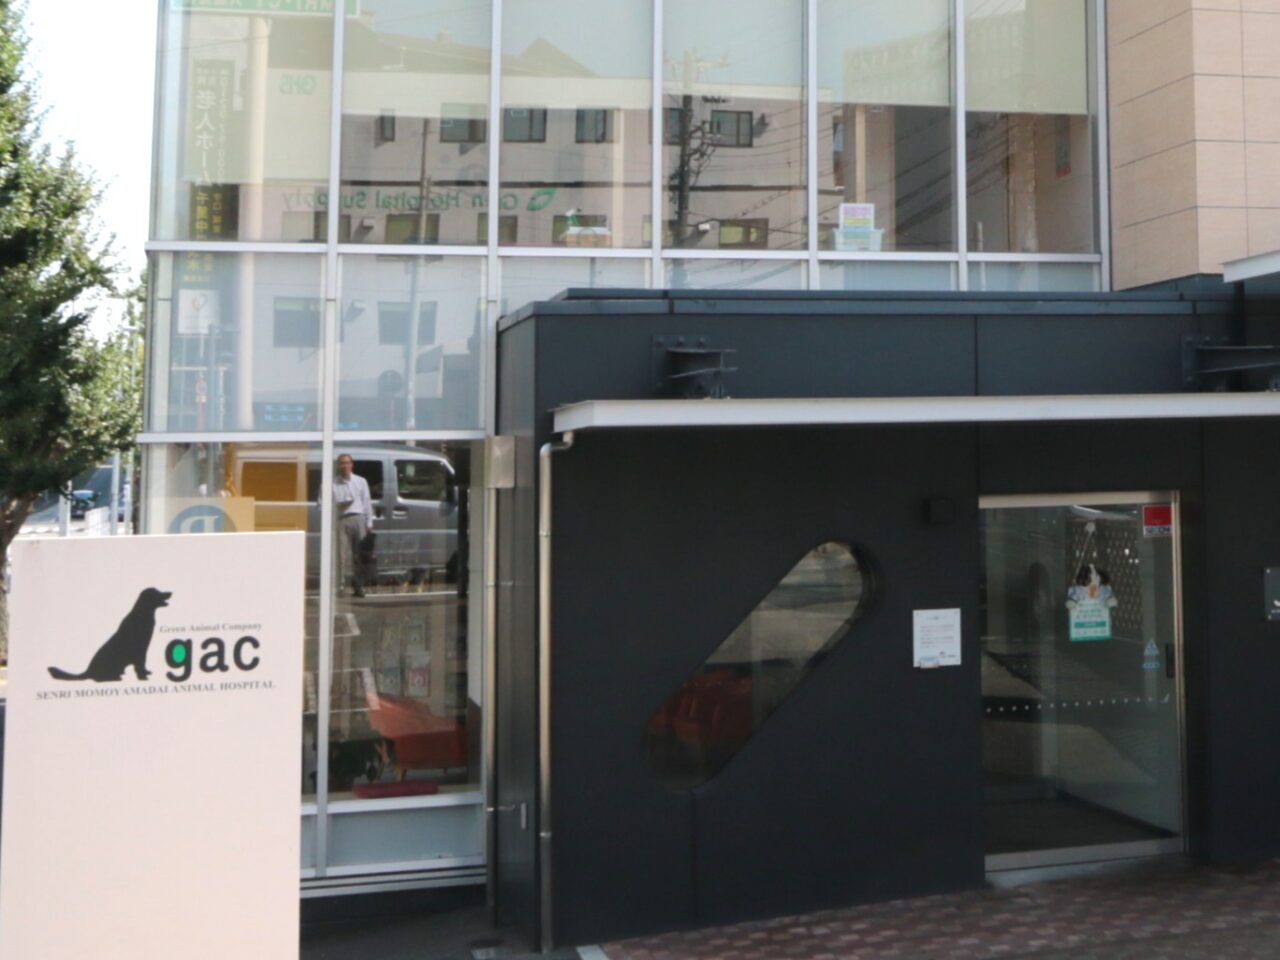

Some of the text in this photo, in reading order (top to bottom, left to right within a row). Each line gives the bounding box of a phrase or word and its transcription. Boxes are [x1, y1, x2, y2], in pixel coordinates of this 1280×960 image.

[159, 622, 262, 634] Green Animal Company
[165, 635, 261, 682] gac
[36, 680, 276, 700] SENRI MOMOYAMADAI ANIMAL HOSPITAL
